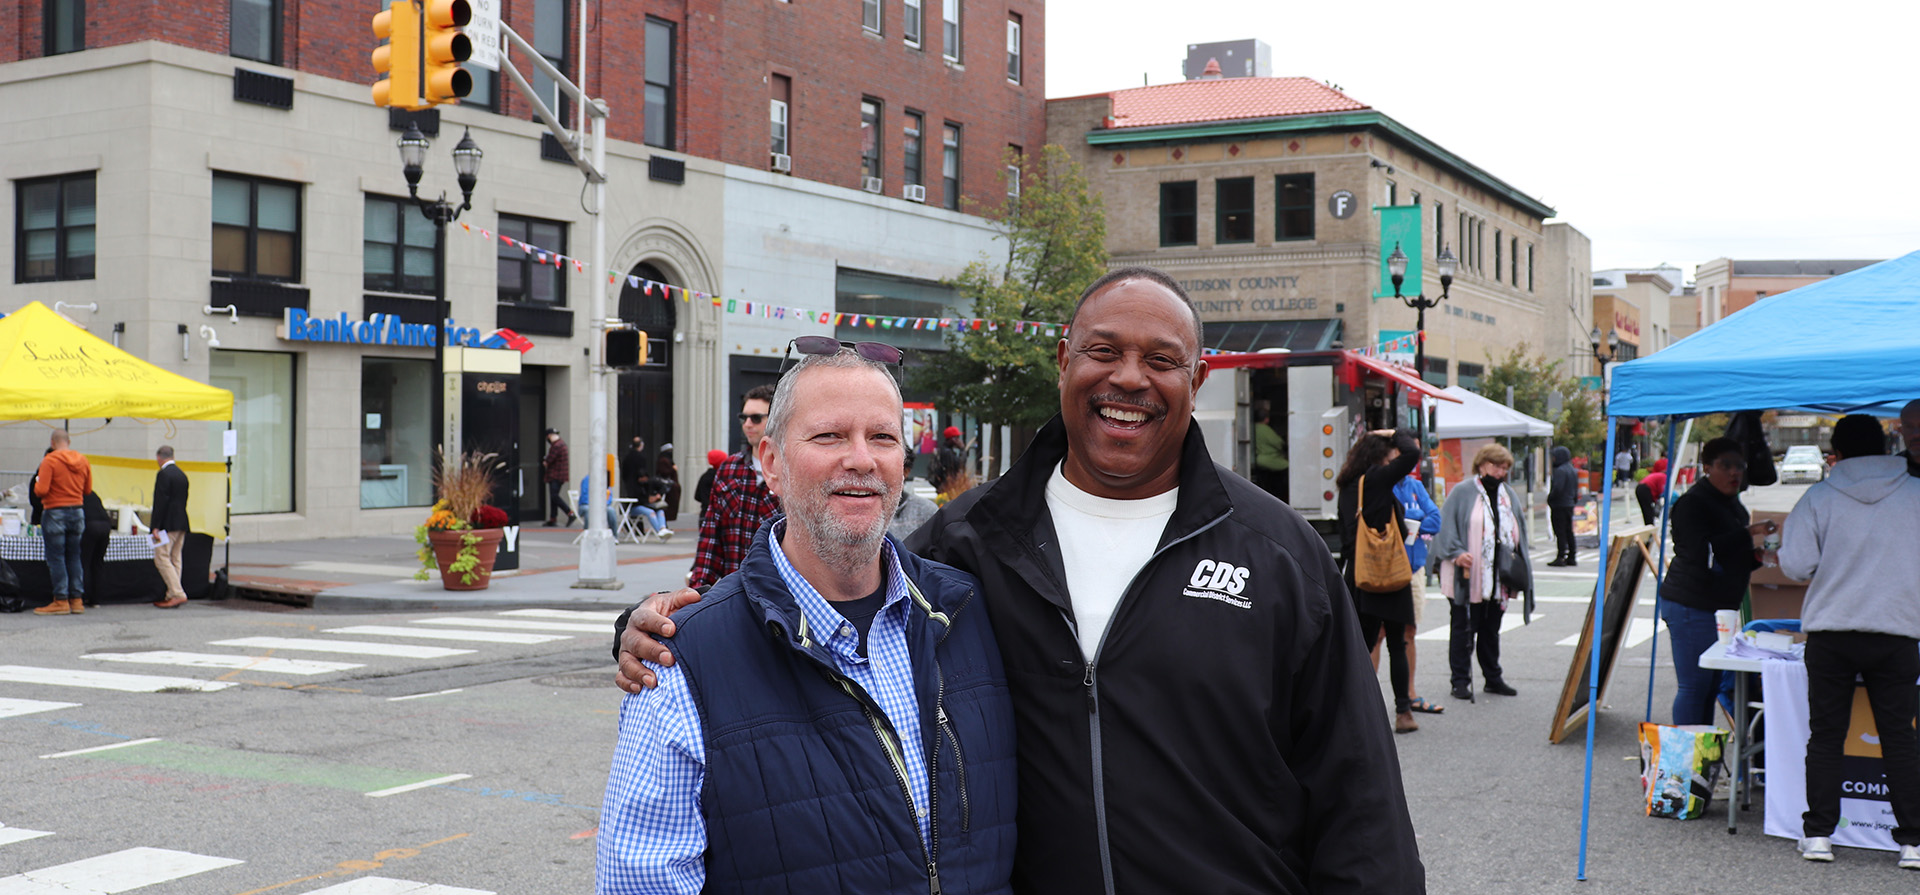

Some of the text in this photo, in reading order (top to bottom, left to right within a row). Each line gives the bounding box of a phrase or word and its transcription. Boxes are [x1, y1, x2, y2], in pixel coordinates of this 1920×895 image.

[478, 0, 489, 11] NO
[473, 14, 493, 30] TURN
[481, 34, 496, 48] RED
[1337, 197, 1348, 216] F
[1238, 276, 1299, 290] COUNTY
[1194, 298, 1318, 313] UNITY COLLEGE
[285, 307, 355, 343] Bank
[358, 313, 385, 345] of
[1190, 559, 1250, 595] CDS
[1183, 588, 1252, 609] Commercial District Services LLC
